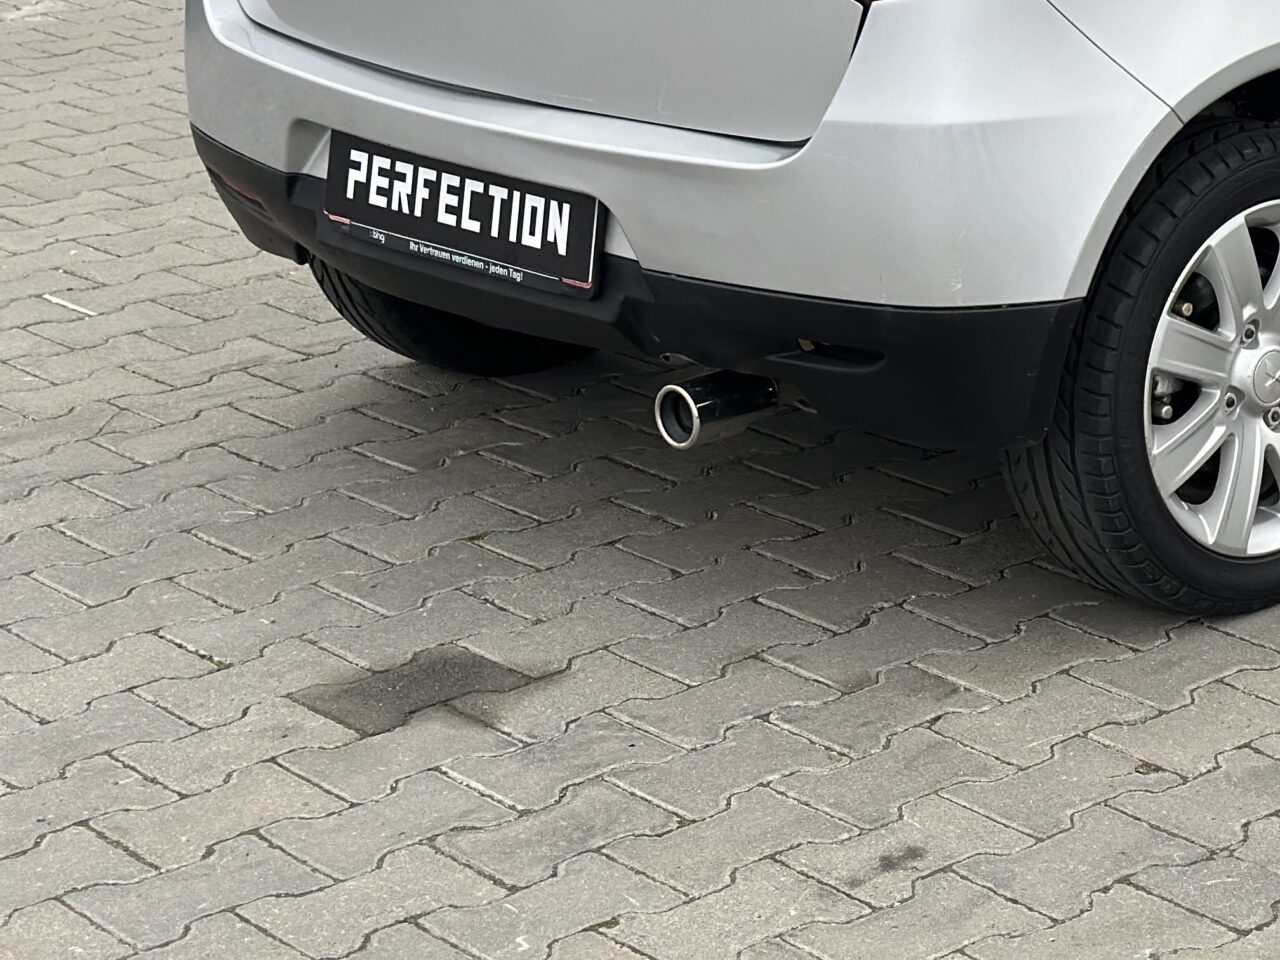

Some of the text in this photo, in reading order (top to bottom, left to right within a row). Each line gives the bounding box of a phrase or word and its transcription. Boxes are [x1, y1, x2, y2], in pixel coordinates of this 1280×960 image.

[346, 149, 571, 256] PERFECTION
[409, 241, 419, 251] Ihr
[419, 244, 451, 261] Vertrauen
[452, 253, 484, 269] verdienen
[489, 263, 508, 277] jeden
[509, 268, 524, 282] Tag!
